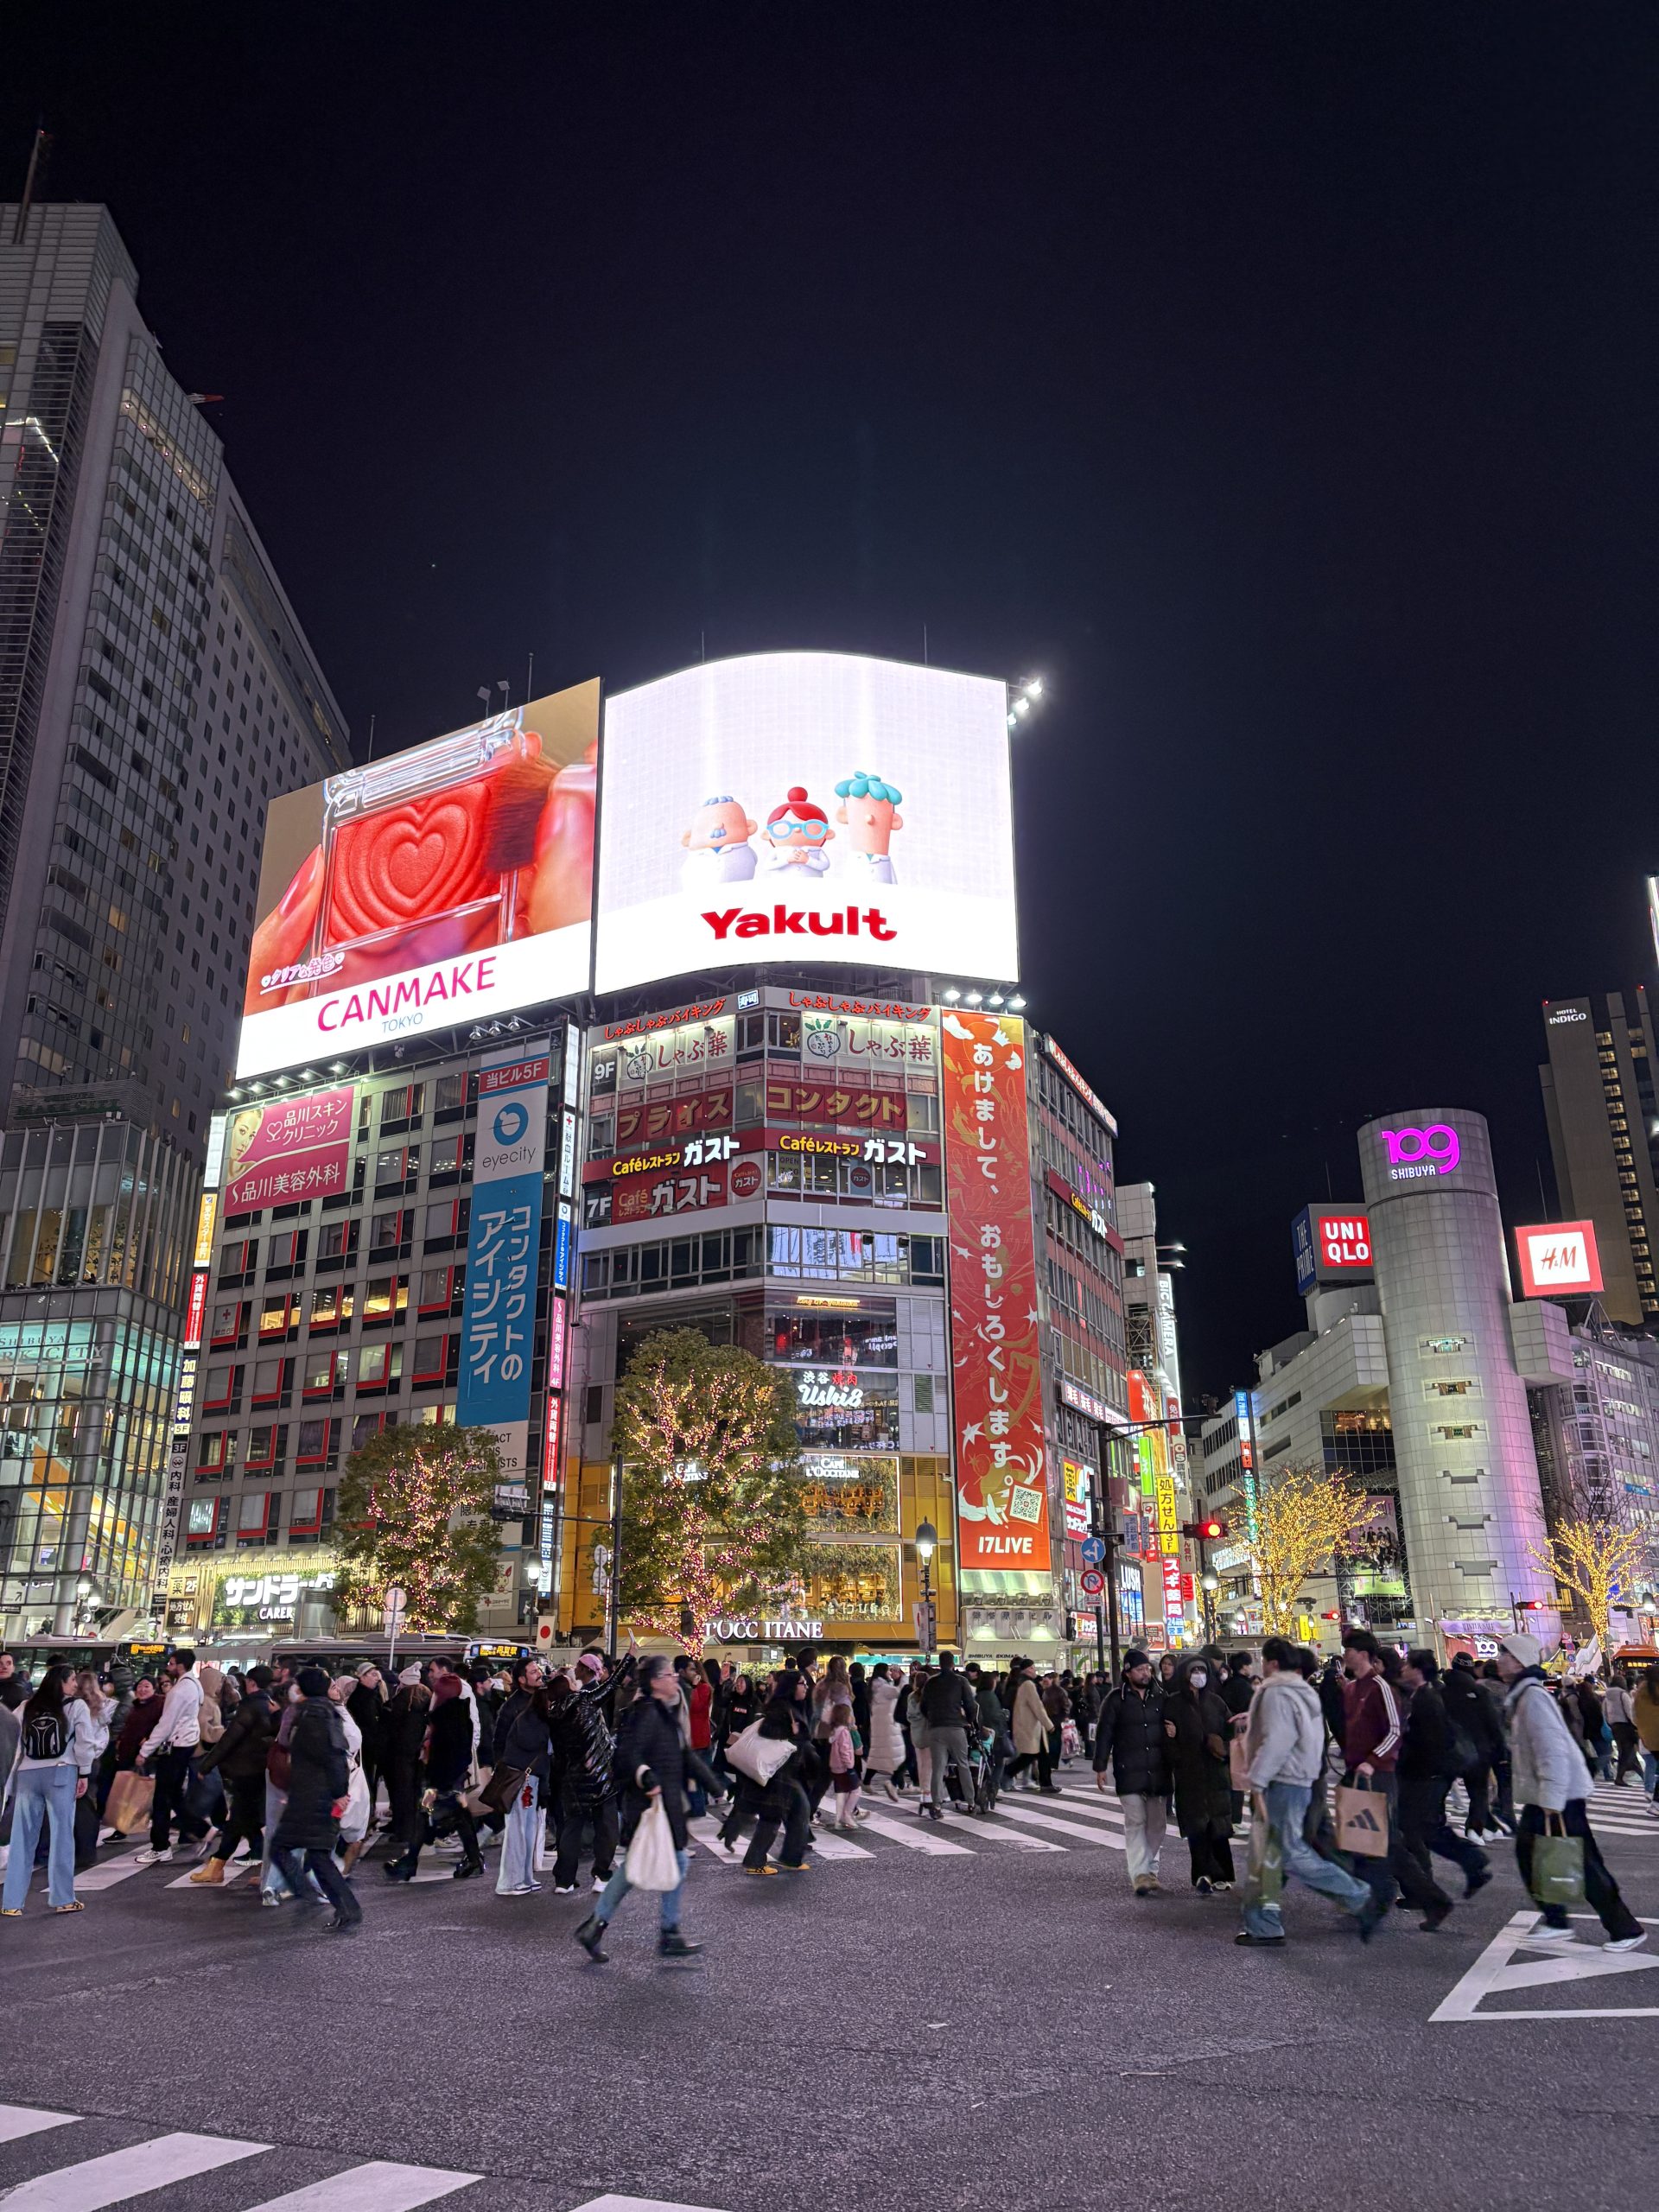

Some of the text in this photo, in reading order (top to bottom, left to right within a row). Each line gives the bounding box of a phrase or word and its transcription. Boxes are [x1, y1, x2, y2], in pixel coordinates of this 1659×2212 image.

[701, 905, 898, 942] Yakult
[270, 953, 336, 986] クリアな発色
[317, 956, 497, 1033] CANMAKE
[739, 991, 758, 1007] 寿司
[789, 991, 931, 1021] しゃぶしゃぶバイキング
[382, 1012, 423, 1033] TOKYO
[604, 998, 726, 1040] しゃぶしゃぶバイキング
[1548, 1013, 1587, 1025] INDIGO
[658, 1031, 728, 1068] しゃぶ葉
[849, 1028, 932, 1061] しゃぶ葉
[486, 1062, 542, 1089] 当ビル5F
[594, 1061, 615, 1080] 9F
[284, 1099, 347, 1128] 品川スキン
[619, 1092, 733, 1140] プライス
[767, 1086, 905, 1122] コンタクト
[283, 1120, 338, 1147] クリニック
[482, 1146, 537, 1171] eyecity
[613, 1135, 741, 1176] Caféレストラン ガスト
[779, 1135, 927, 1166] Caféレストラン ガスト
[1381, 1123, 1460, 1175] 109
[241, 1162, 340, 1202] 品川美容外科
[734, 1176, 759, 1188] ガスト
[853, 1174, 869, 1183] ガスト
[1391, 1164, 1436, 1180] SHIBUYA
[587, 1197, 612, 1217] 7F
[651, 1175, 721, 1215] ガスト
[1091, 1209, 1107, 1239] ガスト
[1296, 1219, 1307, 1249] THE
[1325, 1221, 1363, 1240] UNI
[1296, 1245, 1315, 1279] PRIME
[1328, 1243, 1369, 1263] QLO
[1541, 1245, 1577, 1270] H&M
[192, 1274, 204, 1311] 外貨両替
[470, 1210, 506, 1384] アイシティ
[500, 1205, 531, 1381] コンタクトの
[1158, 1280, 1175, 1357] BIC CAMERA
[0, 1335, 65, 1346] SHIBUYA
[46, 1346, 104, 1359] CITY
[552, 1313, 563, 1374] 品川美容外科
[177, 1359, 196, 1421] 加藤眼科
[551, 1377, 560, 1386] 4F
[798, 1383, 864, 1408] Ushi8
[175, 1425, 188, 1433] 5F
[549, 1397, 559, 1443] 外貨両替
[173, 1444, 187, 1452] 3F
[1175, 1443, 1186, 1462] OS
[168, 1471, 182, 1492] 内科
[1160, 1478, 1175, 1530] 処方せん
[978, 1536, 1033, 1554] 17LIVE
[173, 1578, 183, 1595] 薬
[186, 1579, 197, 1592] 2F
[1121, 1565, 1141, 1592] LUSH
[1164, 1559, 1183, 1616] スギ薬局
[169, 1599, 194, 1611] 処方せん
[174, 1613, 188, 1624] 受付
